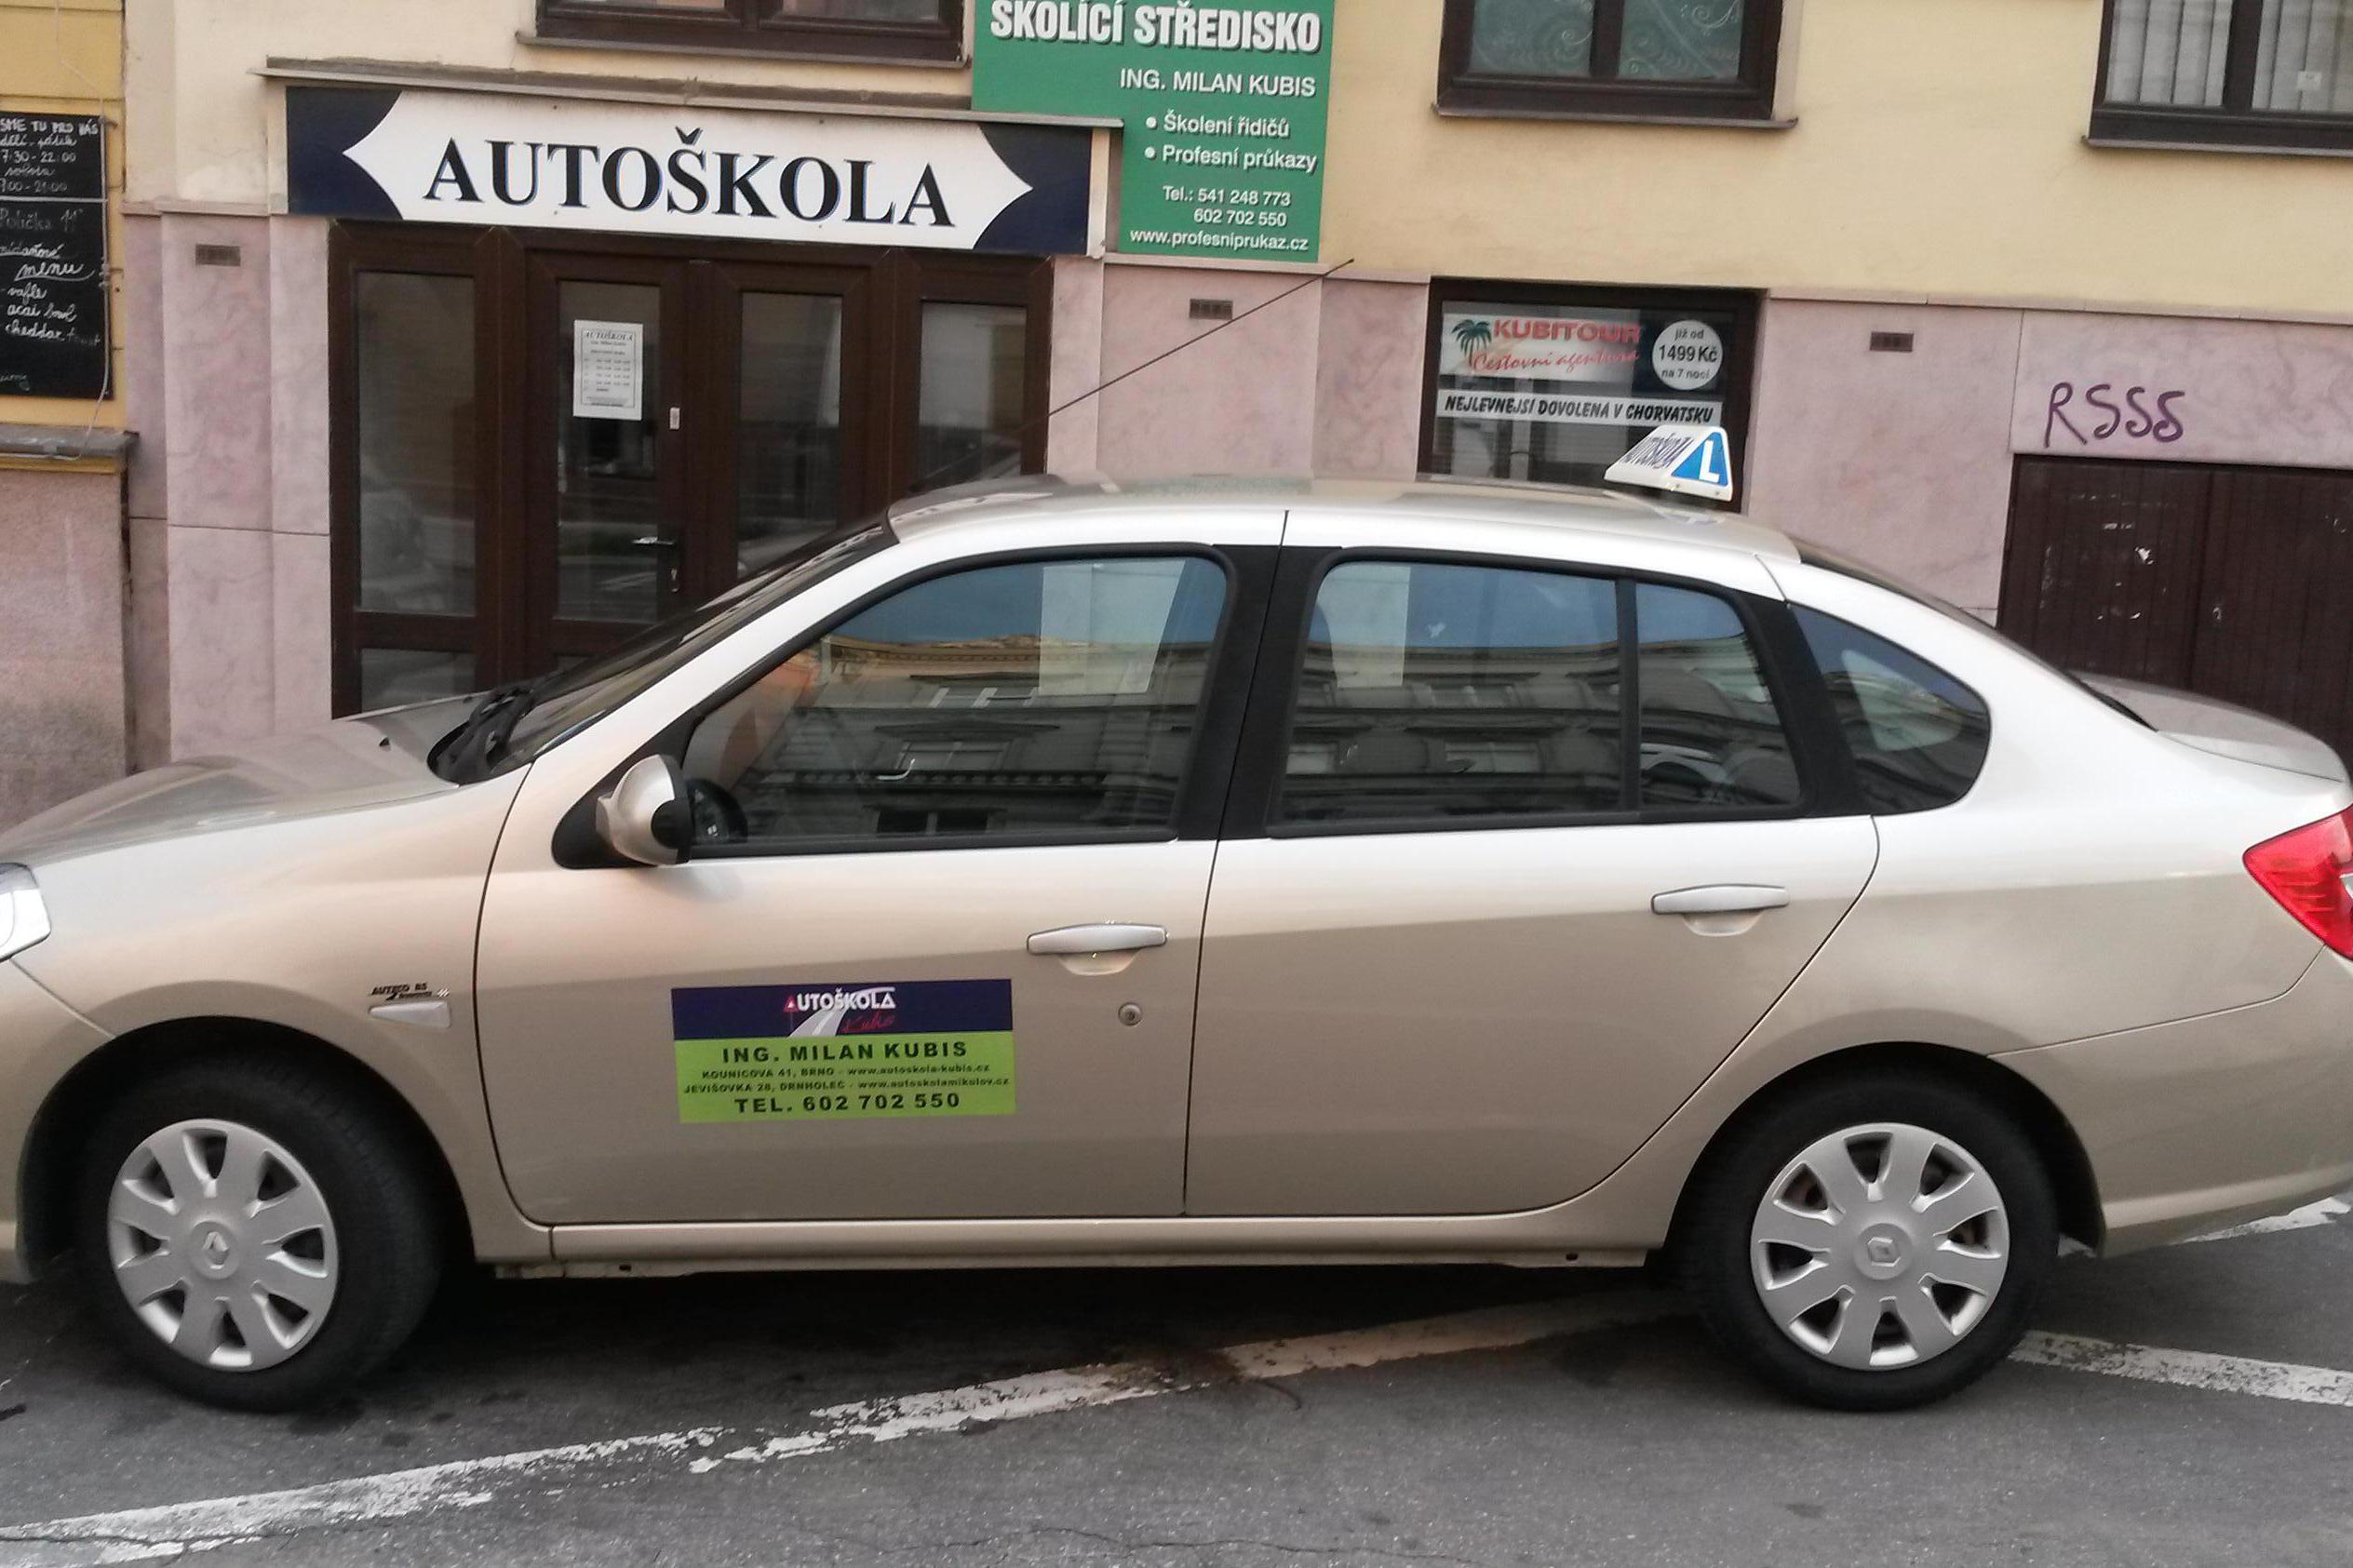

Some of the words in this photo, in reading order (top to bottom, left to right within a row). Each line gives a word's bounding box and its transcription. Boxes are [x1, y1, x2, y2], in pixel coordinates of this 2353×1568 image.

[1133, 0, 1321, 52] STŘEDISKO
[1121, 68, 1166, 90] ING.
[1173, 71, 1243, 94] MILAN
[1249, 74, 1317, 97] KUBIS
[1163, 109, 1234, 135] Školení
[1163, 144, 1240, 167] Profesní
[1244, 149, 1318, 174] průkazy
[423, 126, 956, 228] AUTOŠKOLA
[1163, 185, 1194, 202] Tel.:
[1197, 189, 1225, 204] 541
[1230, 190, 1258, 206] 248
[1263, 191, 1292, 207] 773
[1194, 208, 1223, 224] 602
[1227, 209, 1256, 225] 702
[1258, 212, 1288, 228] 550
[1130, 229, 1310, 251] www.profesniprukaz.cz
[1493, 318, 1641, 343] KUBITOUR
[1690, 328, 1704, 340] od
[1658, 344, 1696, 362] 1499
[1698, 345, 1717, 363] Kč
[1677, 369, 1685, 379] 7
[1613, 403, 1624, 419] V
[1626, 403, 1714, 424] CHORVATSKU
[1699, 439, 1720, 483] L
[783, 986, 896, 1013] AUTOŠKOLA
[722, 1047, 780, 1063] ING.
[790, 1043, 874, 1061] MILAN
[884, 1040, 968, 1058] KUBIS
[702, 1069, 774, 1079] KOUNICOVA
[800, 1067, 835, 1077] BRNO
[733, 1097, 793, 1113] TEL.
[802, 1095, 849, 1112] 602
[858, 1094, 905, 1110] 702
[914, 1092, 961, 1108] 550
